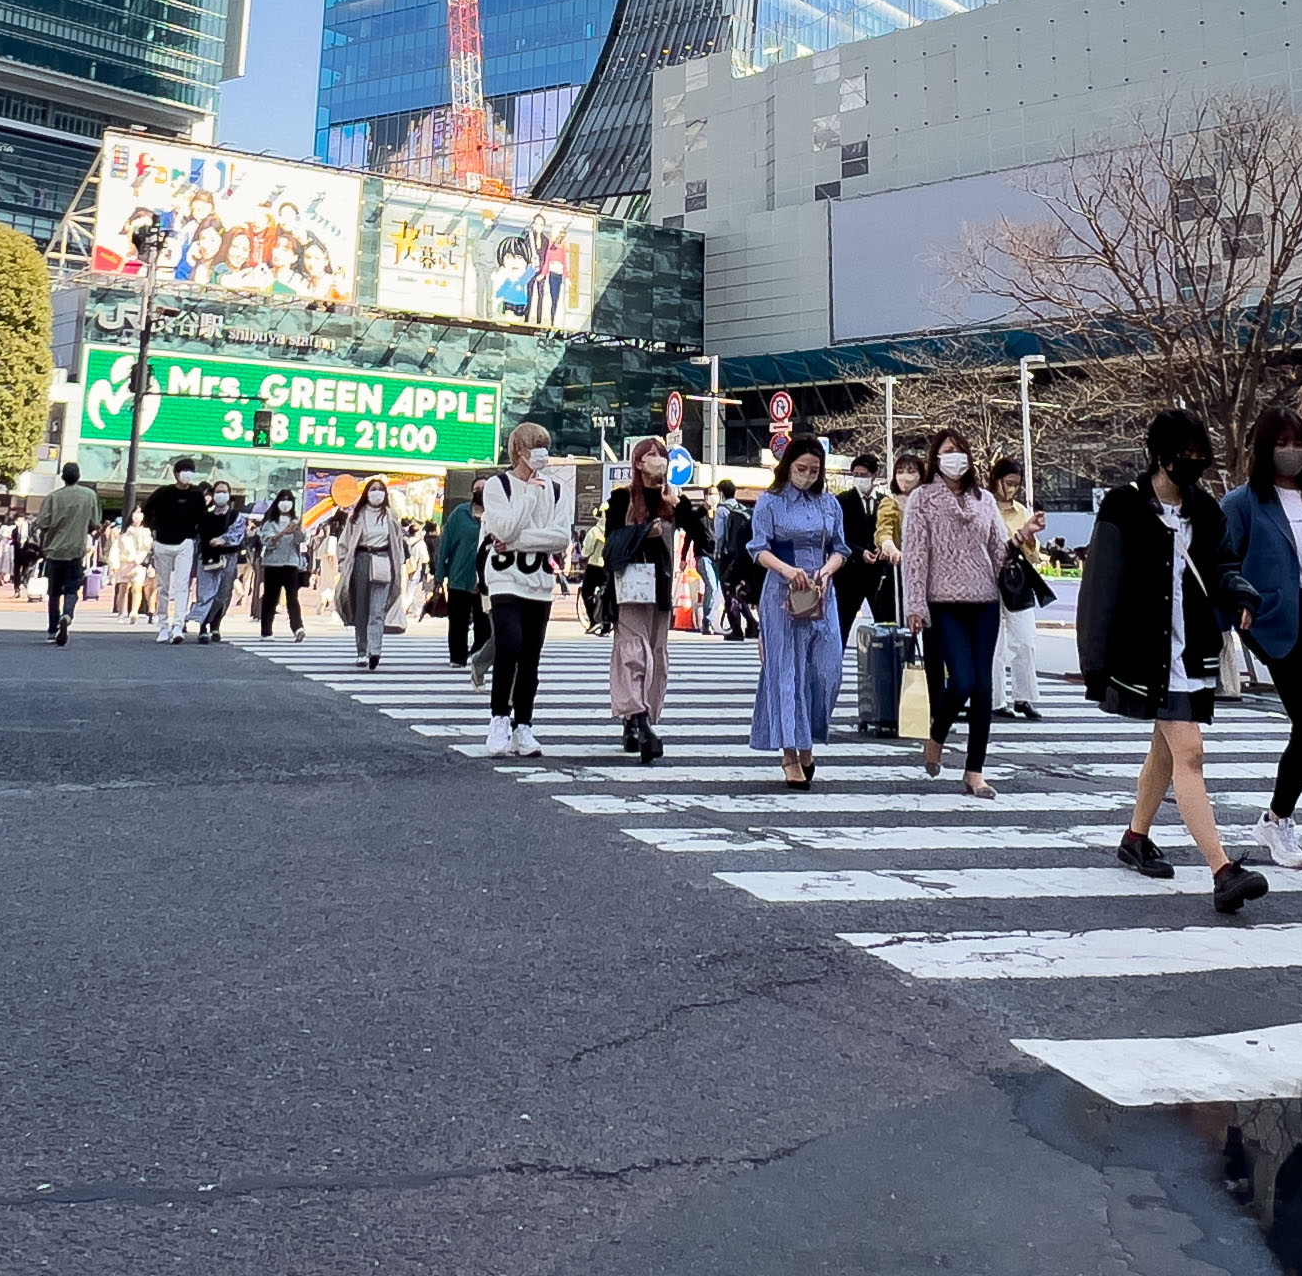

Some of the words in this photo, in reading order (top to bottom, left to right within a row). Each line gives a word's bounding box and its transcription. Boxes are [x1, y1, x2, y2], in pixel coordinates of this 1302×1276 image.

[98, 302, 142, 331] JR
[167, 365, 250, 406] Mrs.
[259, 373, 384, 416] GREEN
[388, 385, 496, 424] APPLE
[221, 410, 290, 443] 3.8
[298, 416, 345, 448] Fri.
[354, 420, 438, 454] 21:00
